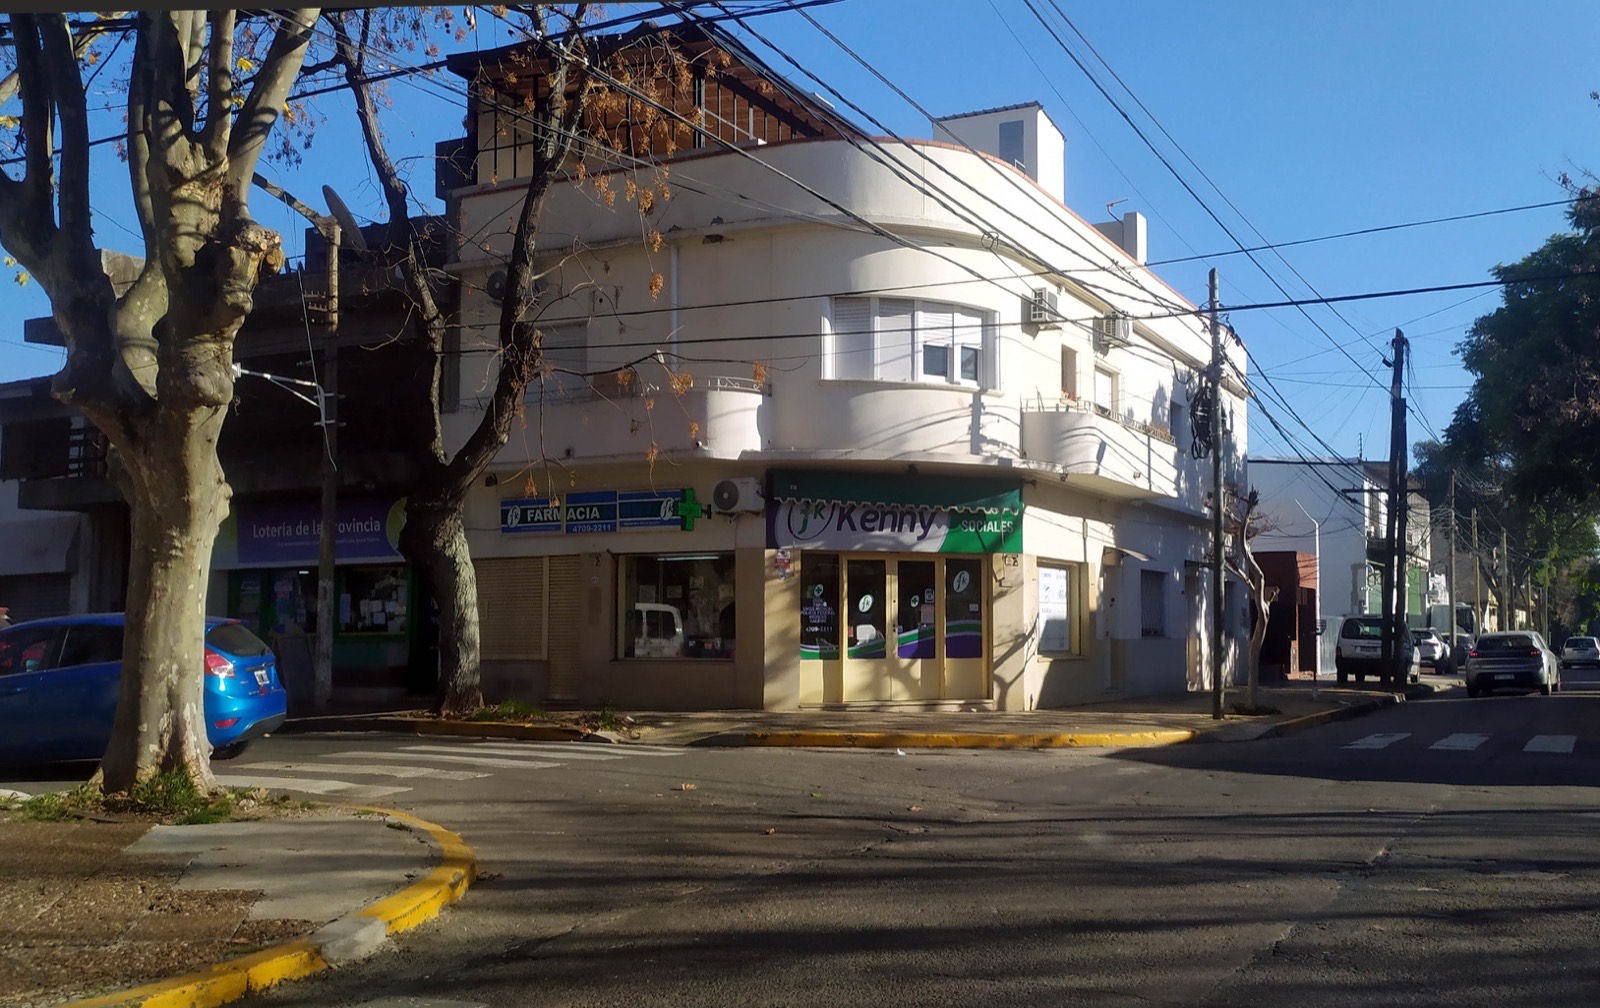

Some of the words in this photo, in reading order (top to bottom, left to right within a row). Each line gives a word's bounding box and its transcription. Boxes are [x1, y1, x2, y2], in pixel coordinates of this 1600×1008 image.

[527, 506, 600, 522] FARMACIA
[253, 521, 292, 538] Lotería
[296, 519, 310, 536] de
[335, 517, 381, 534] ovincia
[572, 524, 611, 533] 4709-2211
[837, 504, 937, 541] Kenny
[961, 520, 1014, 533] SOCIALES
